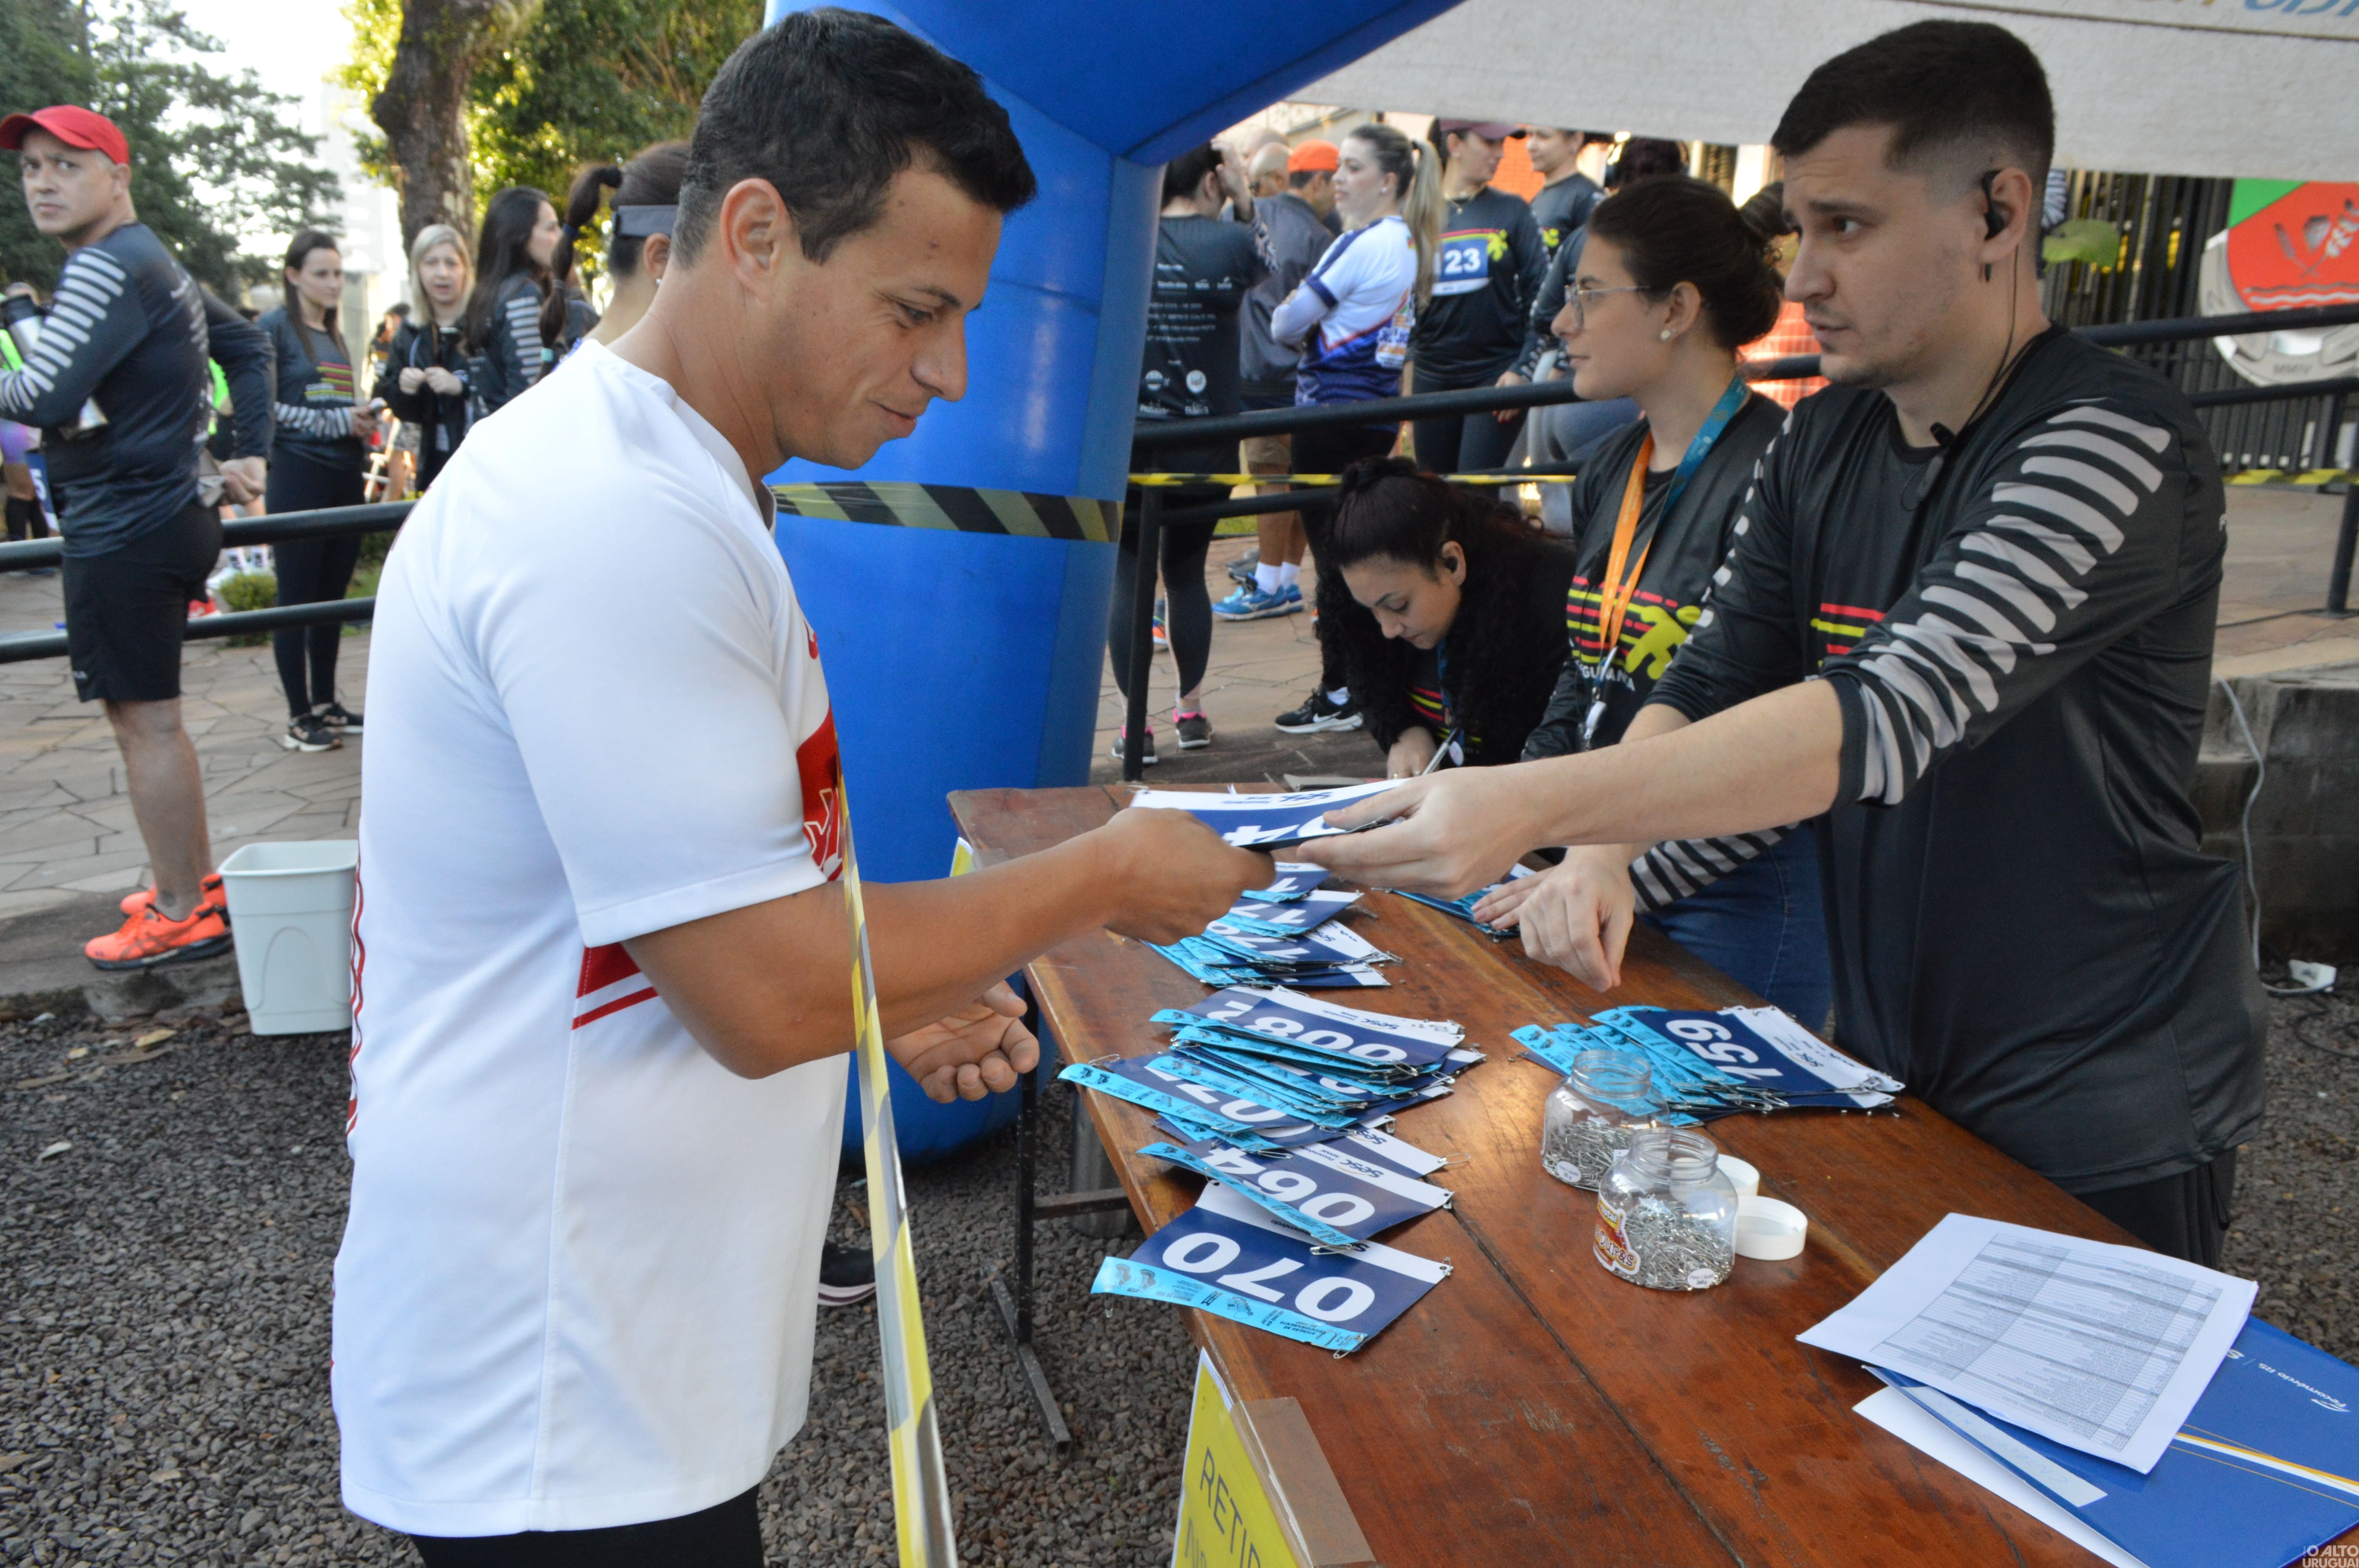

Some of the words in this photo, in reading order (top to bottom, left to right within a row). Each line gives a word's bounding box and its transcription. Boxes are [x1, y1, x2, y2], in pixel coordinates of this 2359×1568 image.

[1665, 1020, 1784, 1082] 159
[1201, 1147, 1375, 1227] 064
[1162, 1232, 1375, 1321] 070
[1279, 1321, 1325, 1334] OSICIONAMENTO
[1291, 1327, 1316, 1336] ATENÇÃO
[2259, 1363, 2276, 1373] RS
[2277, 1372, 2347, 1408] Fecomércio
